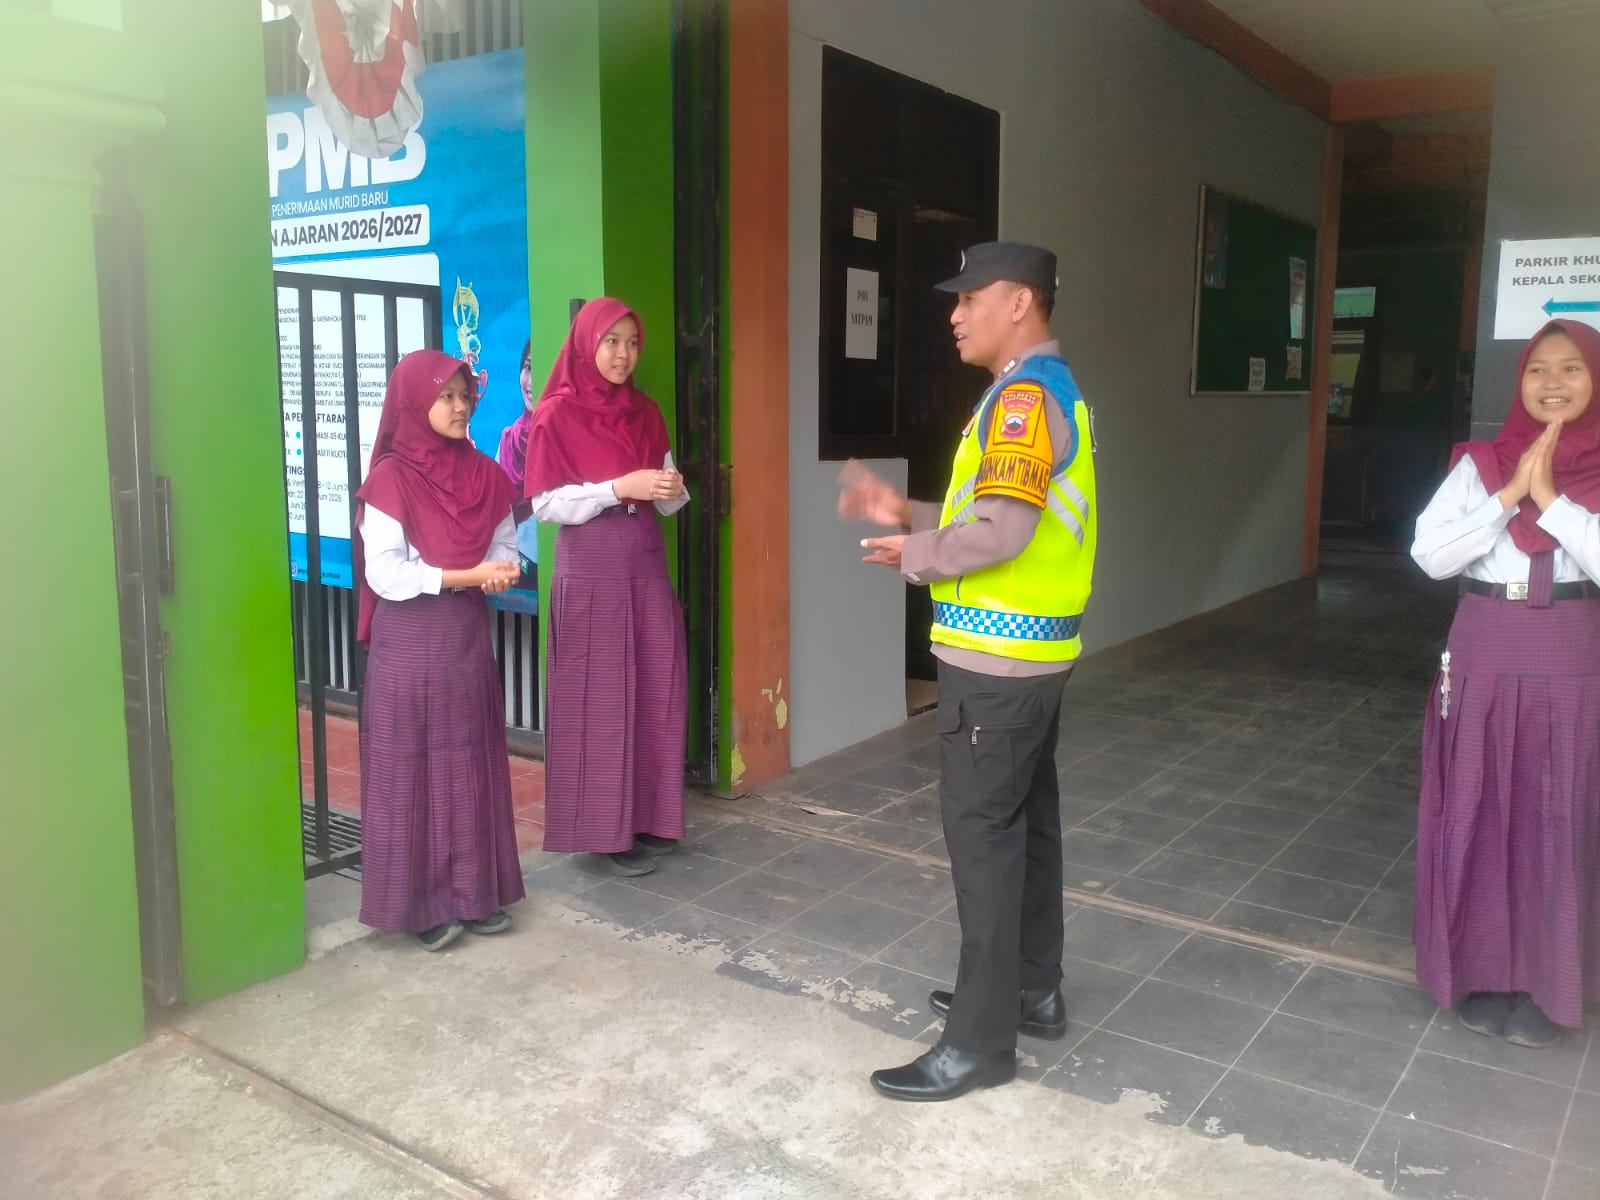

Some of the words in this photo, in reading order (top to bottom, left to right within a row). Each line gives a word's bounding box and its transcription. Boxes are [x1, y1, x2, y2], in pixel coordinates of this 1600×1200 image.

[271, 199, 328, 217] PENERIMAAN
[329, 194, 360, 210] MURID
[361, 191, 389, 207] BARU
[280, 222, 339, 247] AJARAN
[341, 211, 422, 243] 2026/2027
[1515, 256, 1569, 268] PARKIR
[1512, 276, 1565, 286] KEPALA
